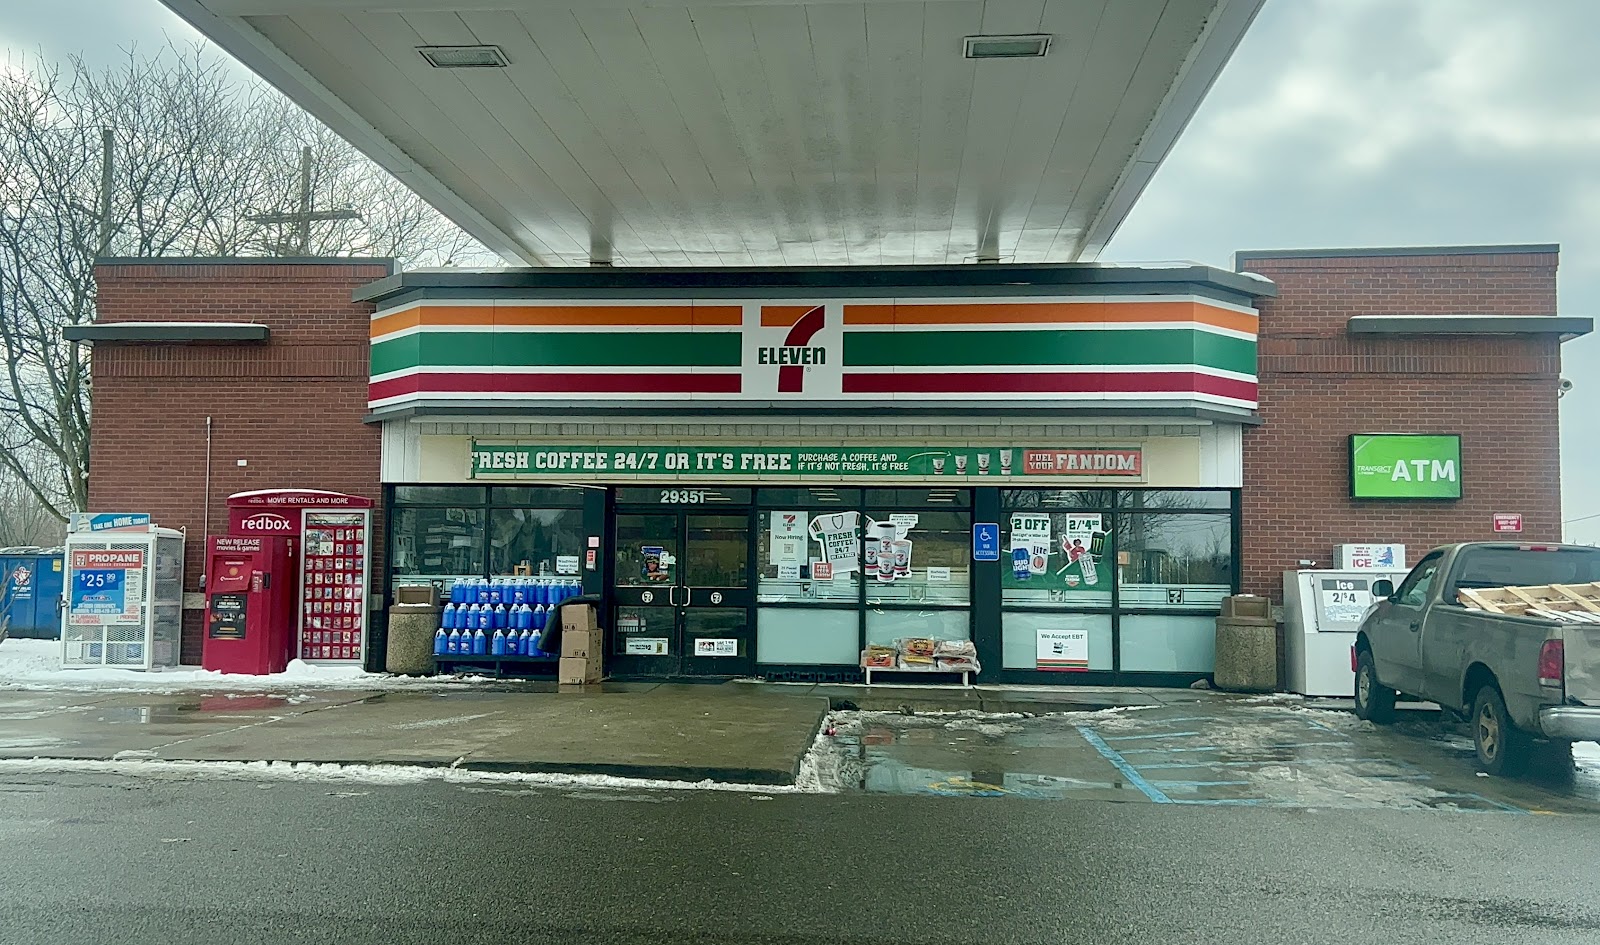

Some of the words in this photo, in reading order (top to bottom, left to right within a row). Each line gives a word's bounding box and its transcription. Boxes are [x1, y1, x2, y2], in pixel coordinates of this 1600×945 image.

[535, 452, 608, 469] COFFEE
[614, 452, 659, 470] 24/7
[664, 452, 690, 470] OR
[696, 453, 734, 470] IT'S
[740, 453, 792, 470] FREE
[797, 453, 838, 462] PURCHASE
[841, 453, 847, 462] A
[849, 453, 878, 462] COFFEE
[880, 453, 898, 462] AND
[1029, 453, 1053, 462] FUEL
[1056, 454, 1136, 471] FANDOM
[797, 462, 806, 471] IF
[807, 462, 823, 471] IT'S
[824, 462, 840, 471] NOT
[872, 462, 888, 471] IT'S
[889, 462, 909, 471] FREE
[1029, 462, 1054, 470] YOUR
[1390, 459, 1456, 482] ATM
[660, 490, 706, 504] 29351
[113, 516, 133, 527] HOME
[241, 516, 291, 530] redbox
[1024, 518, 1050, 531] OFF
[827, 531, 853, 541] FRESH
[233, 538, 260, 546] RELEASE
[828, 538, 854, 548] COFFEE
[1032, 545, 1048, 556] Lite
[88, 553, 140, 563] PROPANE
[1352, 558, 1372, 568] ICE
[106, 572, 116, 581] 99
[1336, 579, 1355, 590] Ice
